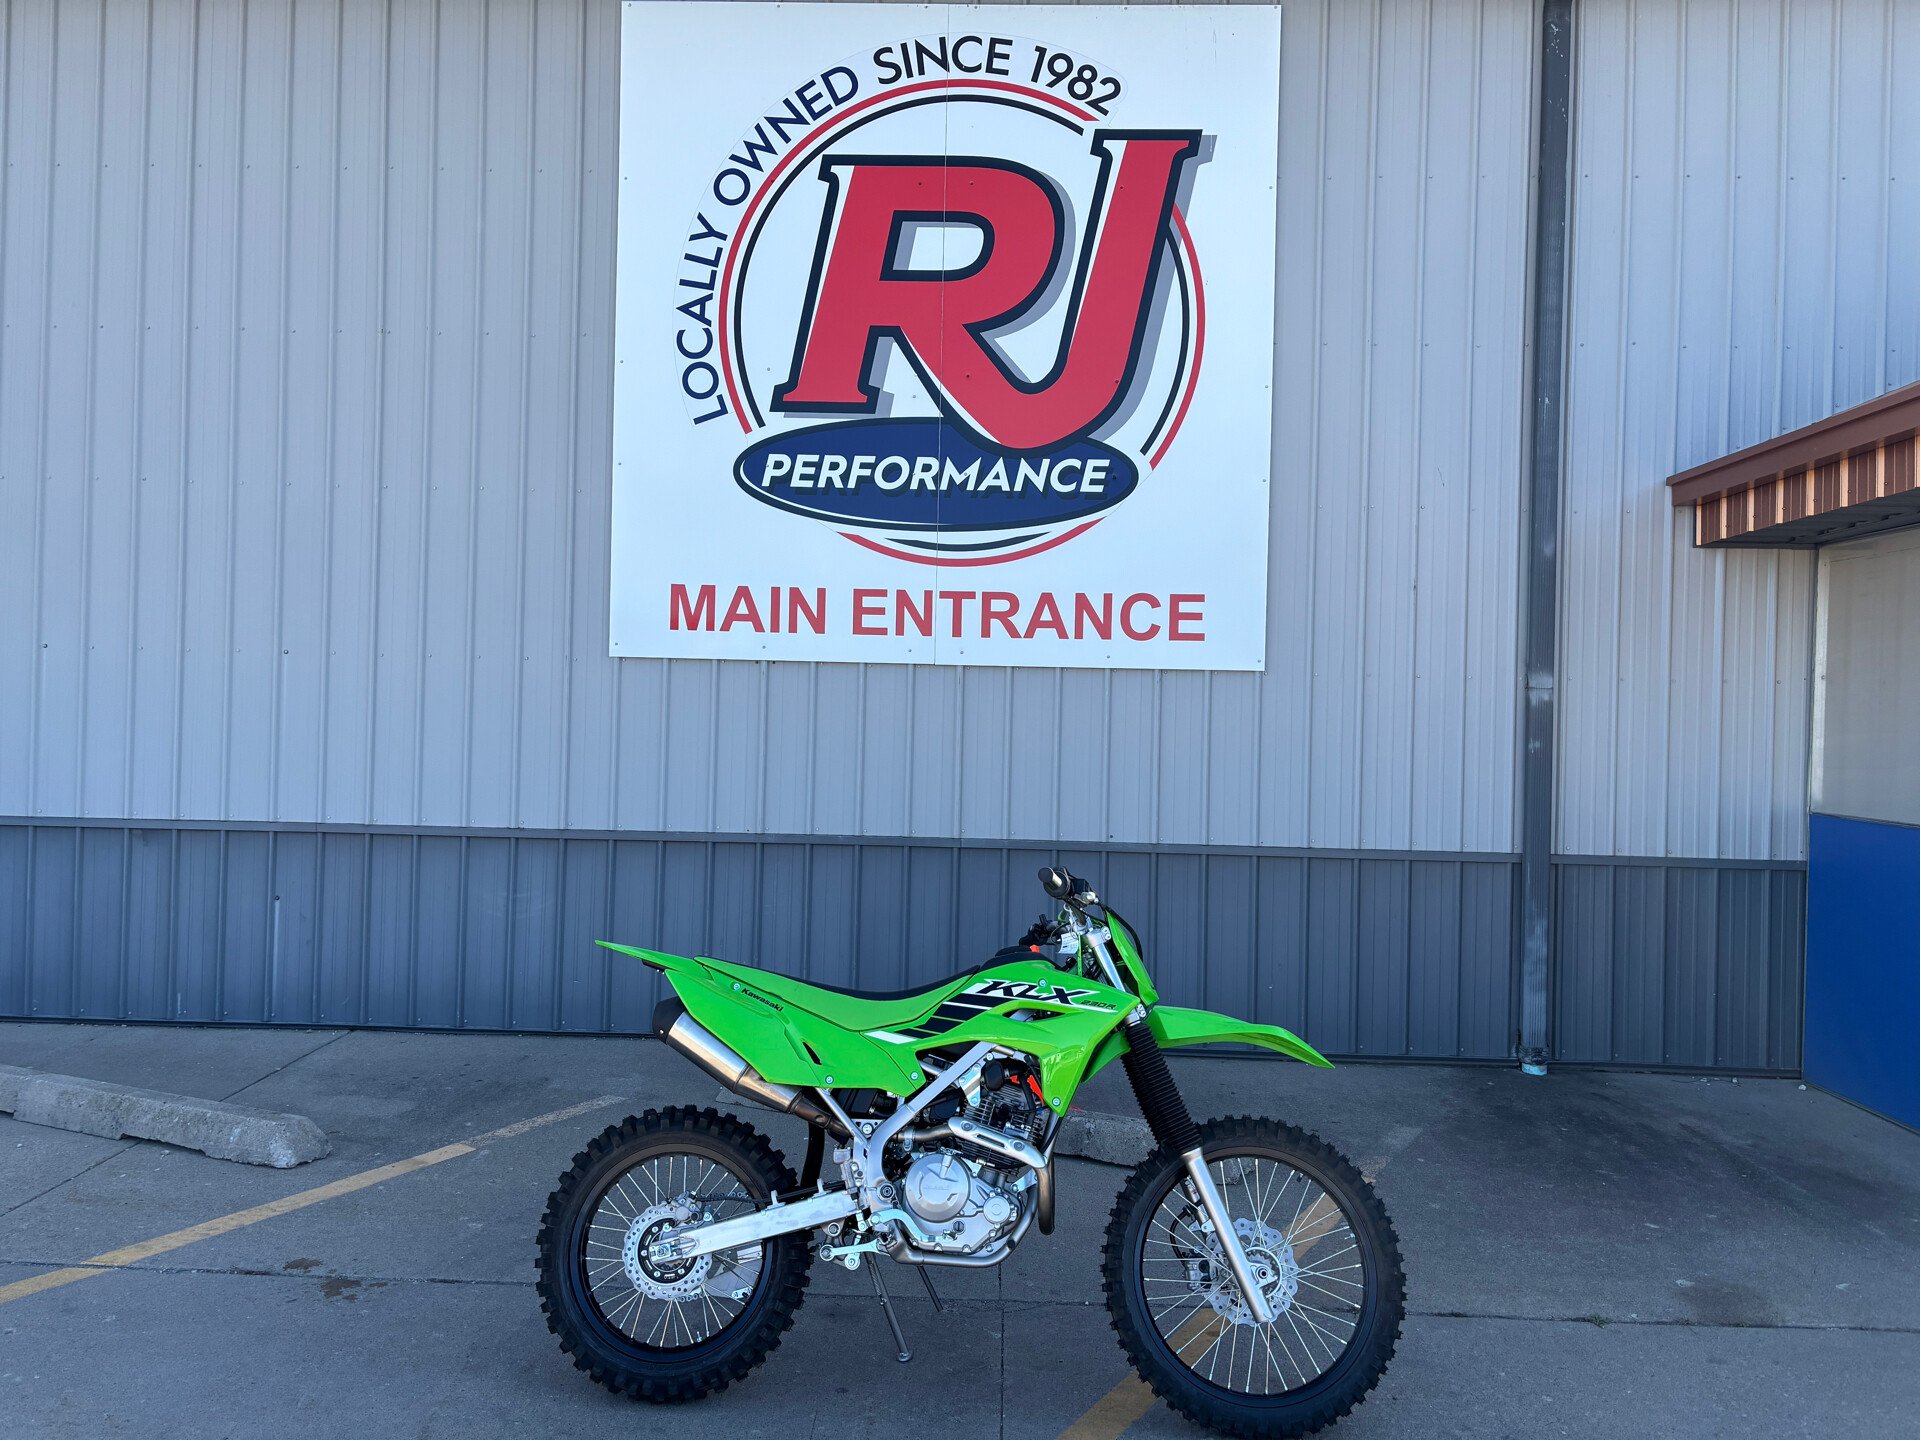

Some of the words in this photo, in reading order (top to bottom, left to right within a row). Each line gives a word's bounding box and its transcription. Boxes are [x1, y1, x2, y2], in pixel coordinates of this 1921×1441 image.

[676, 212, 728, 425] LOCALLY
[713, 66, 859, 206] OWNED
[873, 35, 1013, 85] SINCE
[1031, 45, 1121, 117] 1982
[769, 128, 1203, 454] RJ
[761, 453, 1112, 493] PERFORMANCE
[669, 584, 826, 634] MAIN
[852, 588, 1206, 641] ENTRANCE
[741, 988, 784, 1012] Kawasaki
[976, 980, 1092, 1006] KLX
